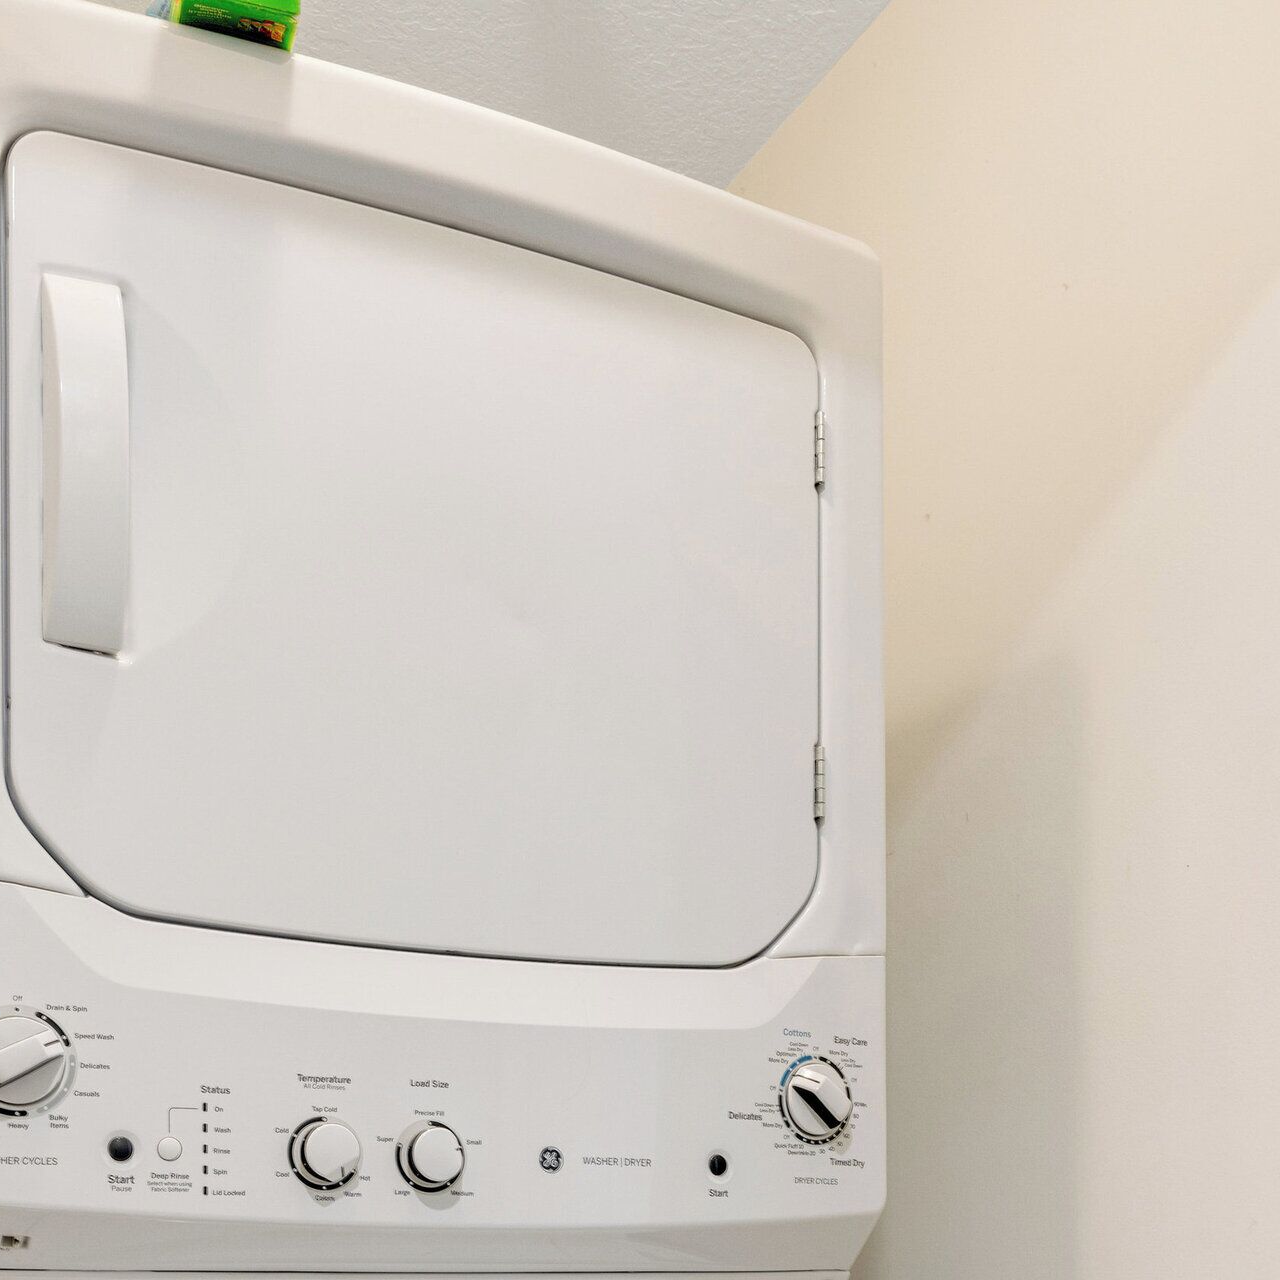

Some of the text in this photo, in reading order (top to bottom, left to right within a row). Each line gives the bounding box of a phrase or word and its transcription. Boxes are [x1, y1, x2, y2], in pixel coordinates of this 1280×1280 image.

[72, 1005, 88, 1013] Spin
[74, 1032, 115, 1041] Speed Wash
[783, 1028, 812, 1038] Cottons
[834, 1035, 868, 1046] Easy Care
[80, 1062, 111, 1070] Delicates
[297, 1073, 352, 1085] Temperature
[410, 1079, 450, 1089] Load Size
[200, 1085, 231, 1095] Status
[49, 1114, 69, 1122] Bulky
[414, 1109, 435, 1117] Precise
[729, 1111, 762, 1121] Delicates
[8, 1122, 29, 1130] Heavy
[22, 1156, 58, 1166] CYCLES
[583, 1156, 652, 1167] WASHER DRYER
[830, 1157, 865, 1168] Timed Dry
[107, 1174, 135, 1184] Start
[150, 1172, 190, 1180] Deep Rinse
[794, 1177, 839, 1185] DRYER CYCLES
[394, 1189, 411, 1197] Large
[709, 1188, 729, 1198] Start
